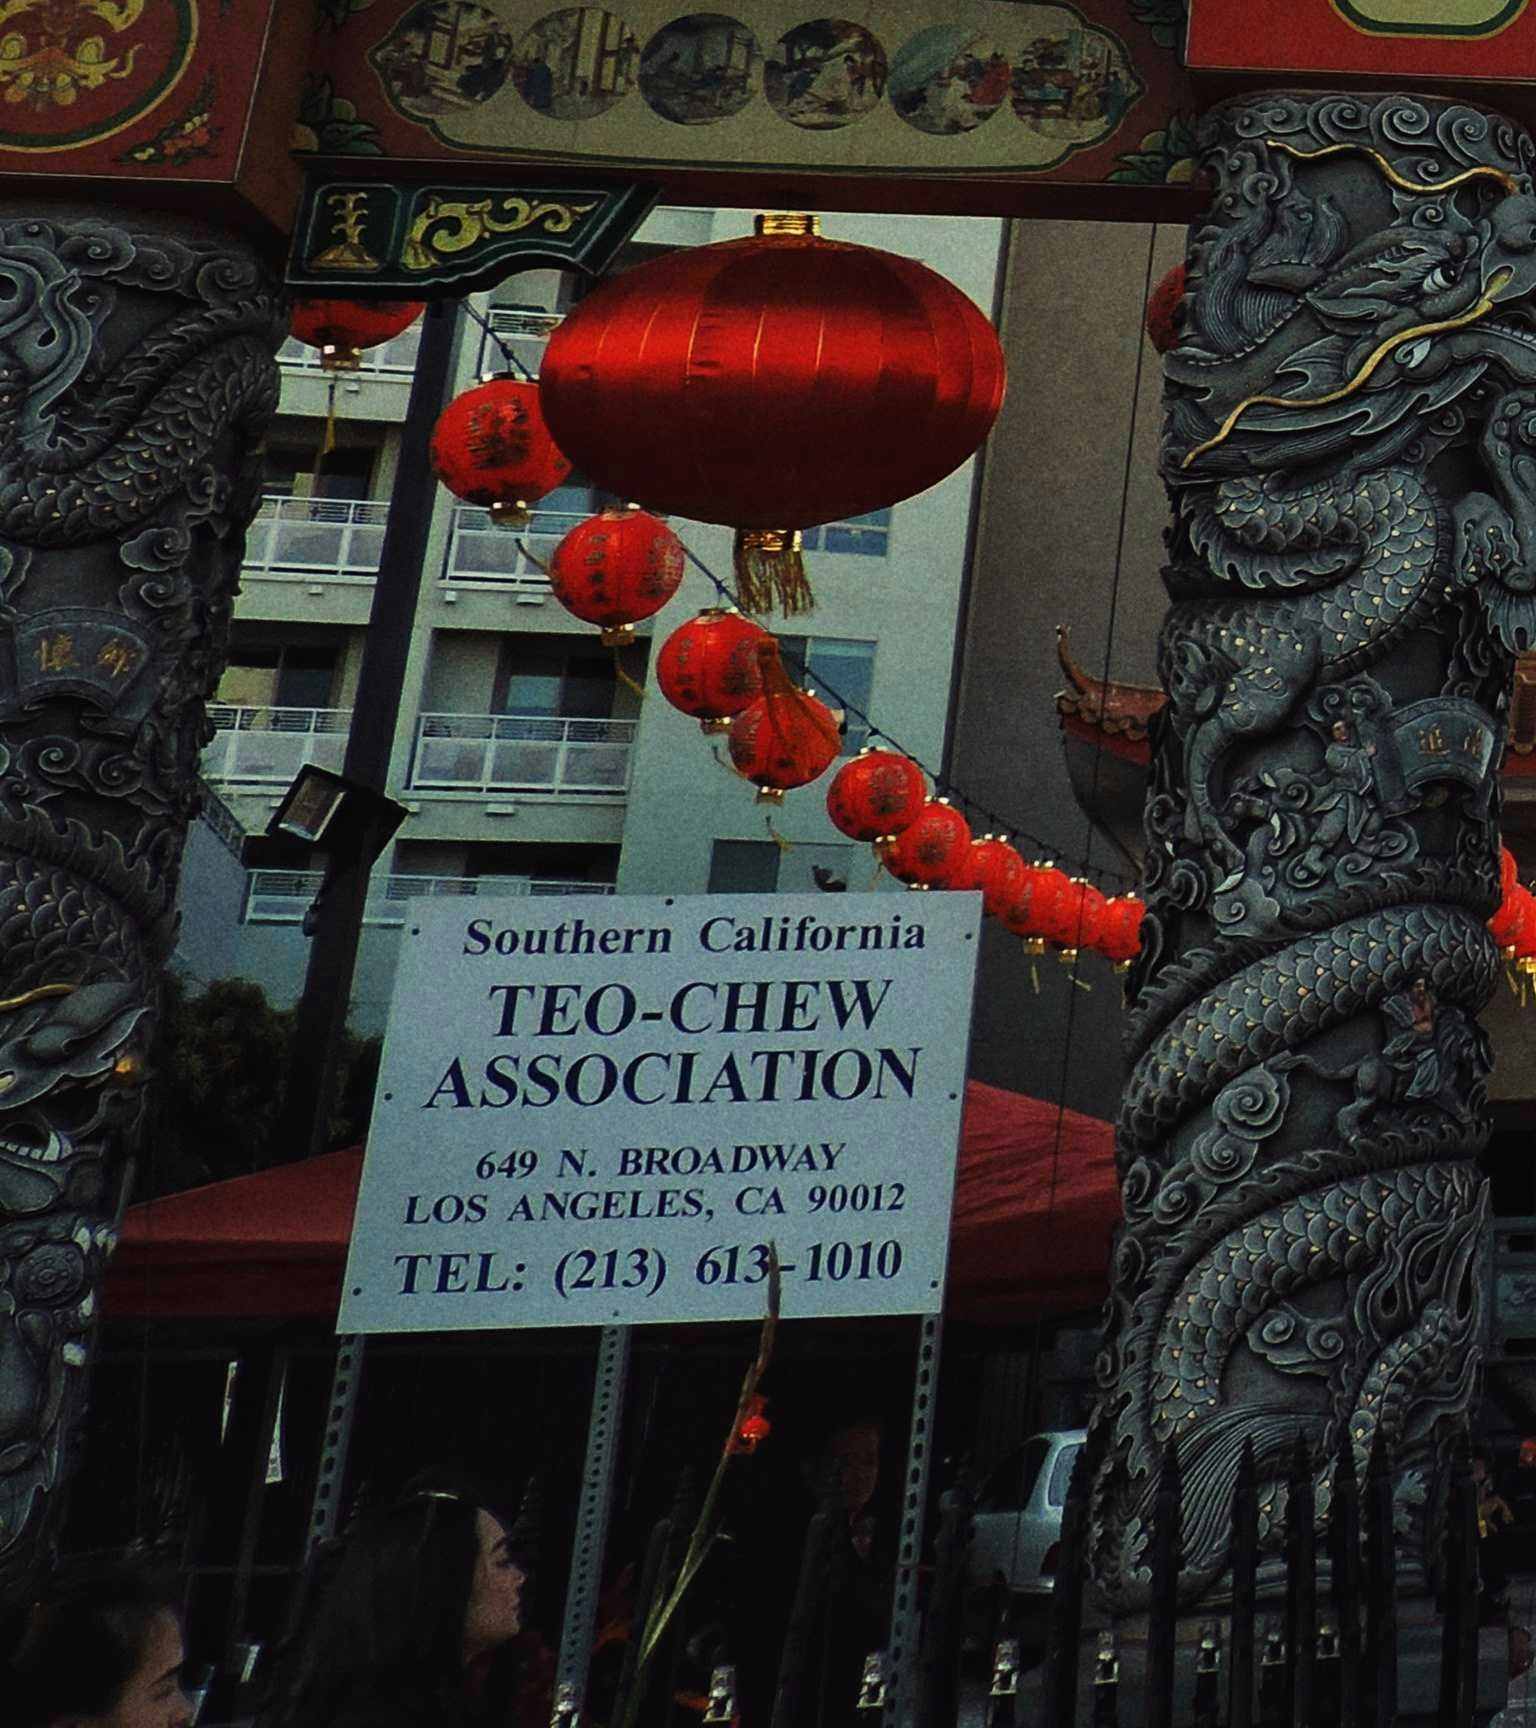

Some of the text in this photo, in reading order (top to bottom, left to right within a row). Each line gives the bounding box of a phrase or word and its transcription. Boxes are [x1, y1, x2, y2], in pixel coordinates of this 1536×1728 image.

[462, 914, 926, 957] Southern California
[488, 978, 895, 1038] TEO-CHEW
[420, 1047, 924, 1109] ASSOCIATION
[475, 1142, 848, 1180] 649 N. BROADWAY
[403, 1182, 906, 1226] LOS ANGELES, CA 90012
[393, 1239, 902, 1299] TEL: (213) 613-1010
